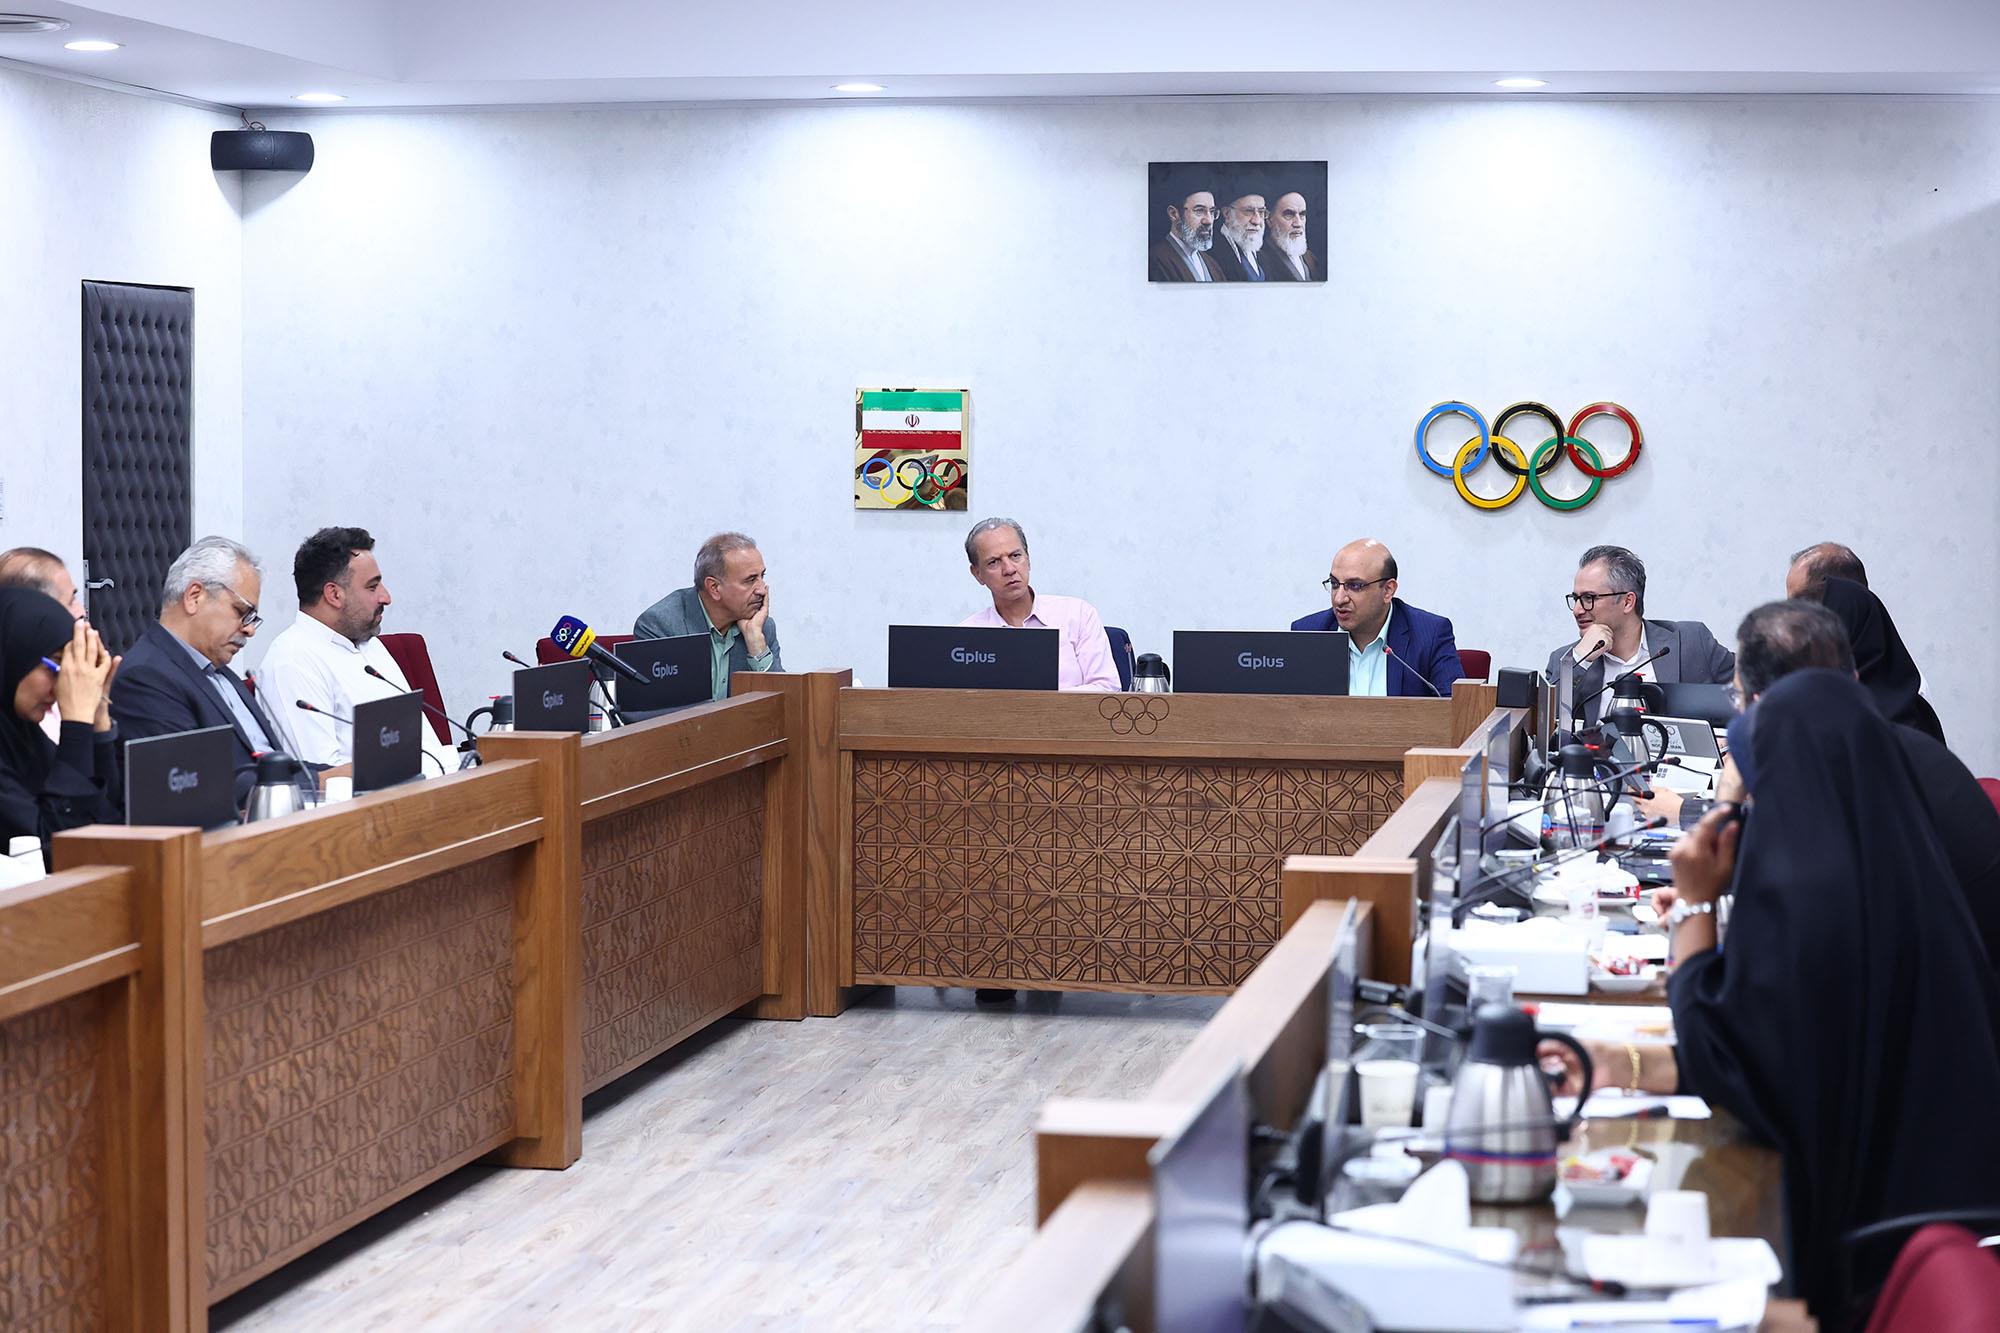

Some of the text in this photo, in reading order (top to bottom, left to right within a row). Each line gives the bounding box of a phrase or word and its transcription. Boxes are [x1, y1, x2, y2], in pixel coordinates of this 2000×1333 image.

[951, 647, 996, 665] Gplus
[1237, 652, 1284, 670] Gplus
[652, 661, 679, 679] Gplus
